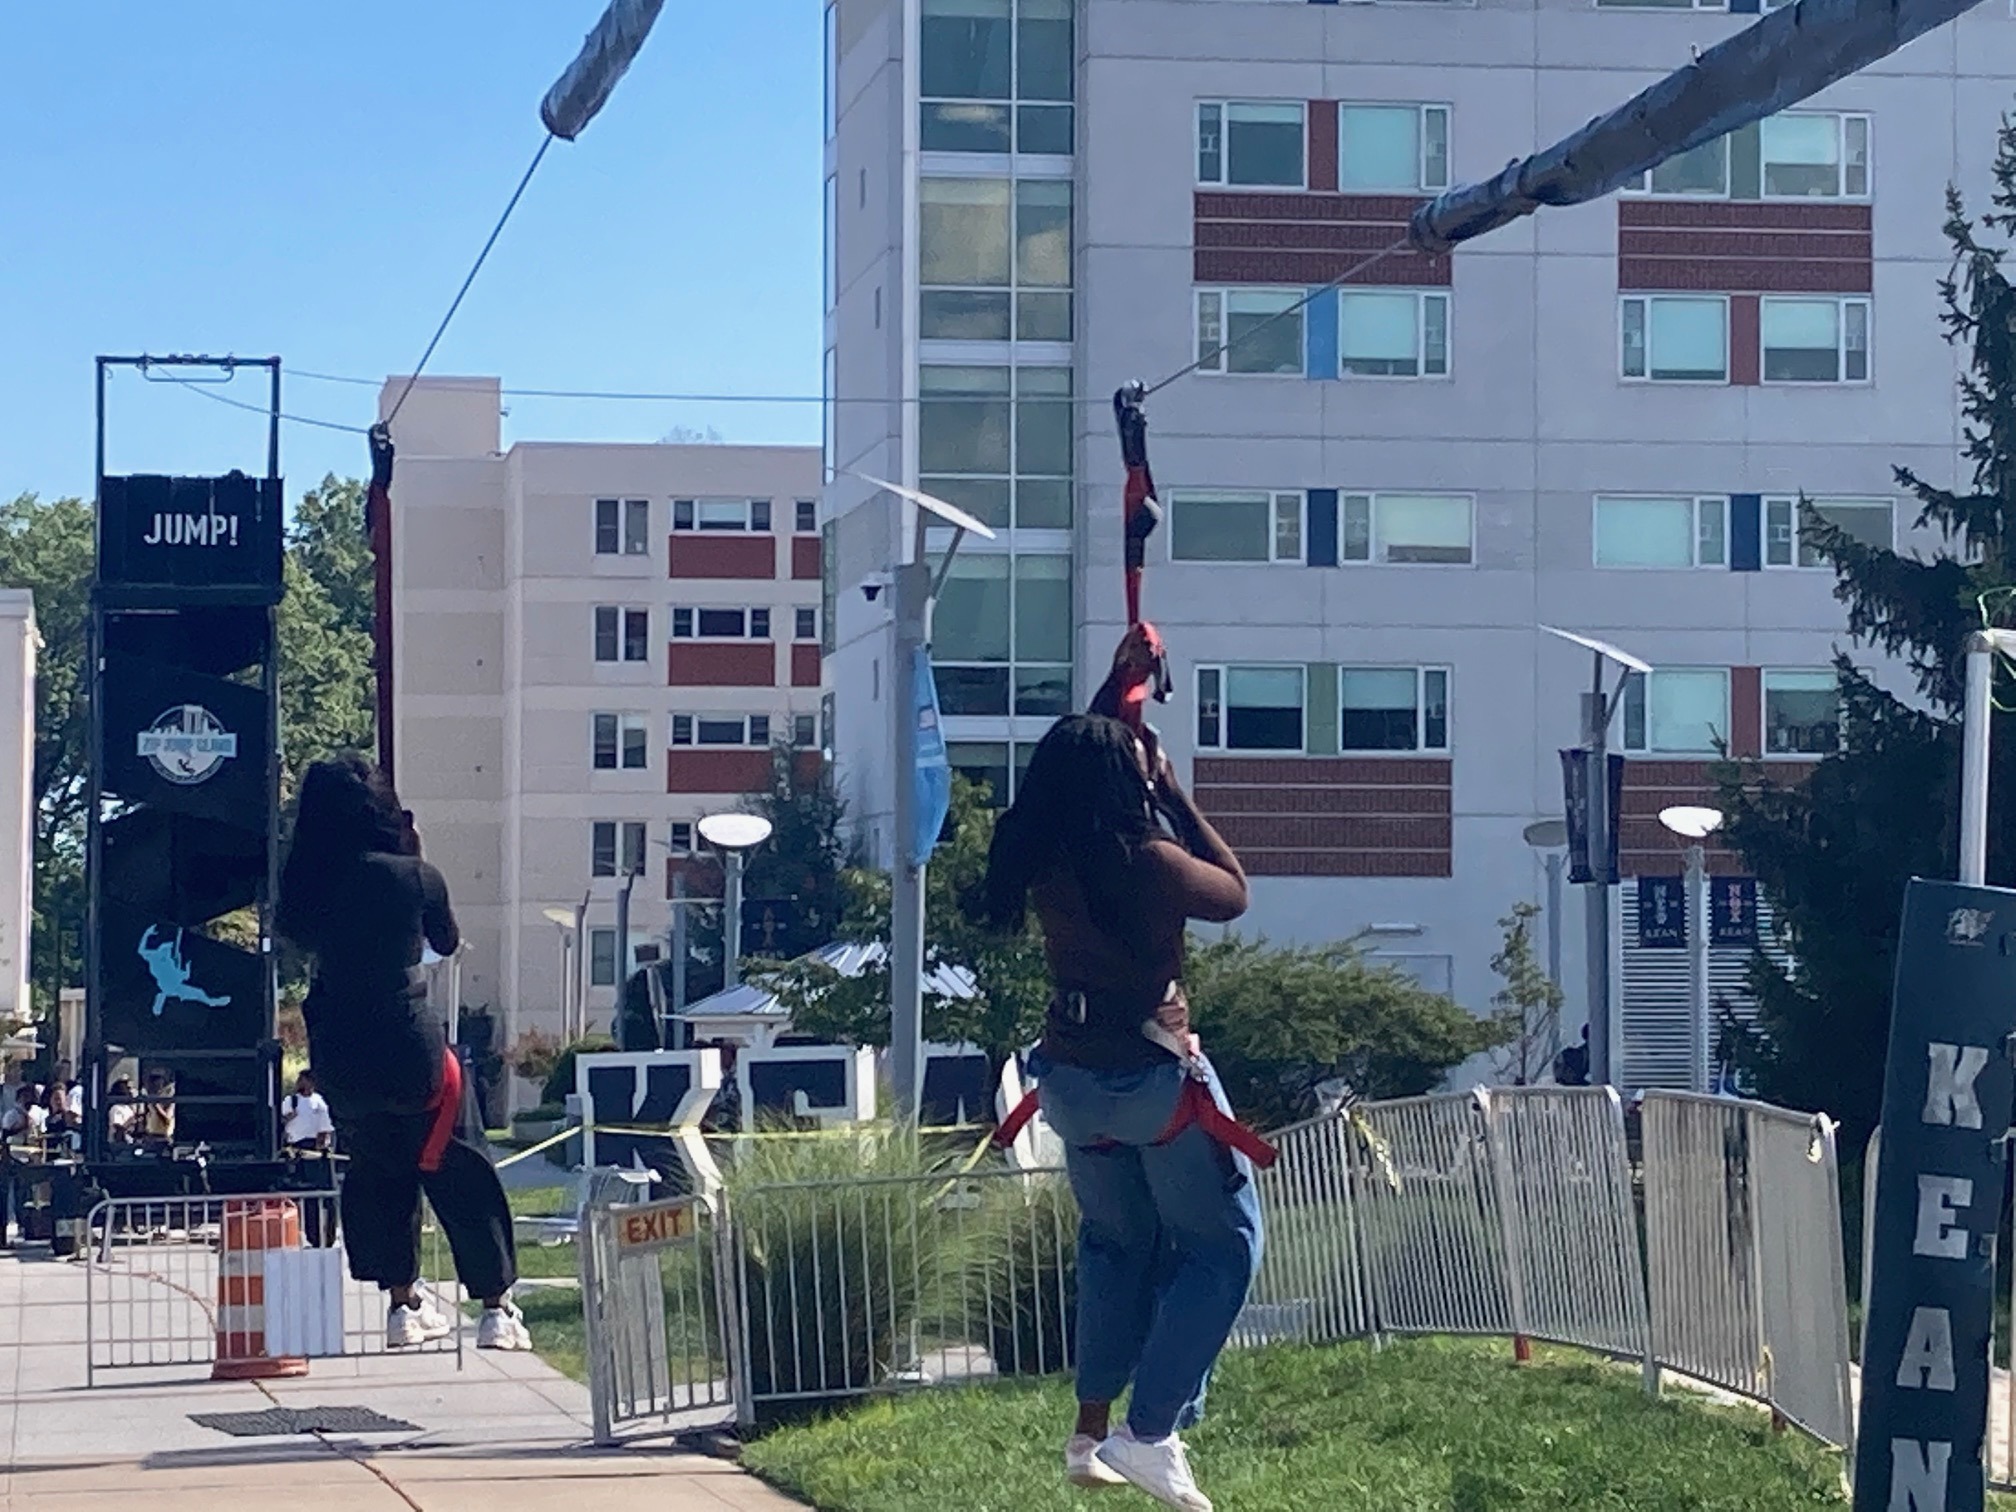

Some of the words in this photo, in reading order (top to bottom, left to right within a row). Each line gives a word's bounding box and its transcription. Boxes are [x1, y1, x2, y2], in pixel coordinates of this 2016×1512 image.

[143, 513, 239, 546] JUMP!
[627, 1209, 681, 1244] EXIT
[1886, 1043, 1989, 1512] KEAN
